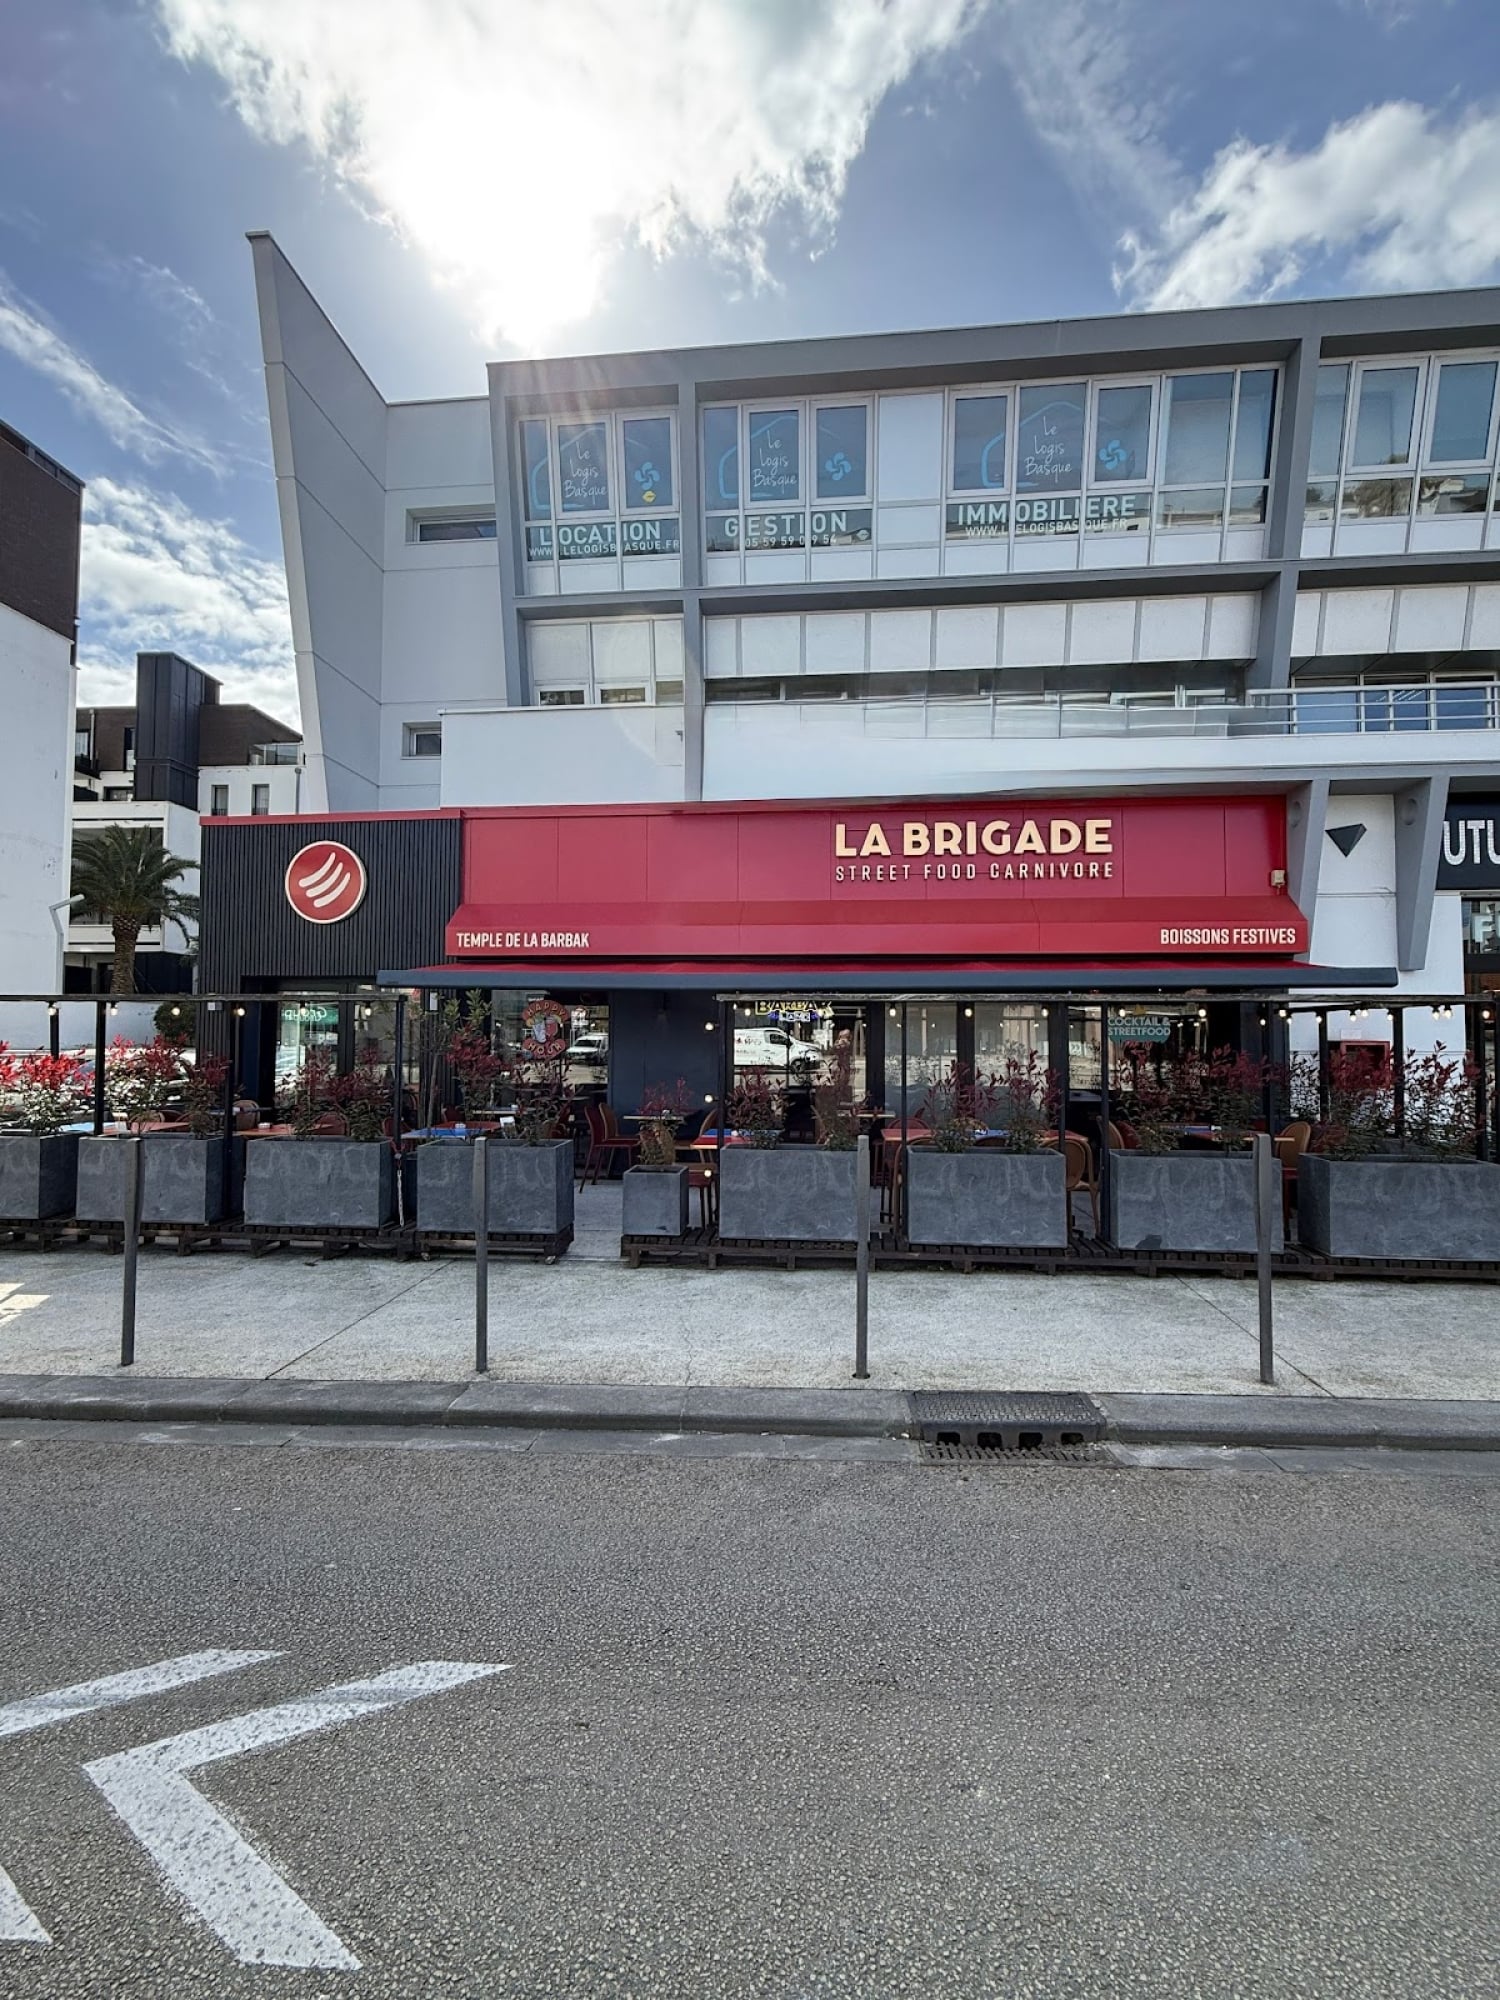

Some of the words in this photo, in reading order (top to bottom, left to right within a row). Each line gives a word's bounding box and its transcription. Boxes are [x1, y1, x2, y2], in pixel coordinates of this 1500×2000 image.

[1043, 415, 1057, 436] Le
[575, 441, 592, 460] Le
[767, 430, 782, 449] Le
[1034, 435, 1065, 464] Logis
[569, 456, 600, 487] Logis
[760, 448, 790, 476] Logis
[1024, 456, 1073, 483] Basque
[564, 480, 607, 505] Basque
[753, 468, 798, 495] Basque
[958, 495, 1137, 526] IMMOBILIERE
[539, 521, 661, 546] LOCATION
[724, 511, 848, 538] GESTION
[835, 823, 892, 857] LA
[903, 819, 1113, 856] BRIGADE
[835, 864, 911, 882] STREET
[924, 863, 976, 880] FOOD
[990, 861, 1113, 880] CARNIVORE
[456, 932, 503, 948] TEMPLE
[506, 932, 521, 948] DE
[524, 932, 538, 948] LA
[541, 932, 590, 948] BARBAK
[1160, 928, 1230, 945] BOISSONS
[1233, 927, 1296, 944] FESTIVES
[1107, 1017, 1161, 1026] COCKTAIL
[1161, 1017, 1171, 1026] &
[1107, 1027, 1171, 1036] STREETFOOD
